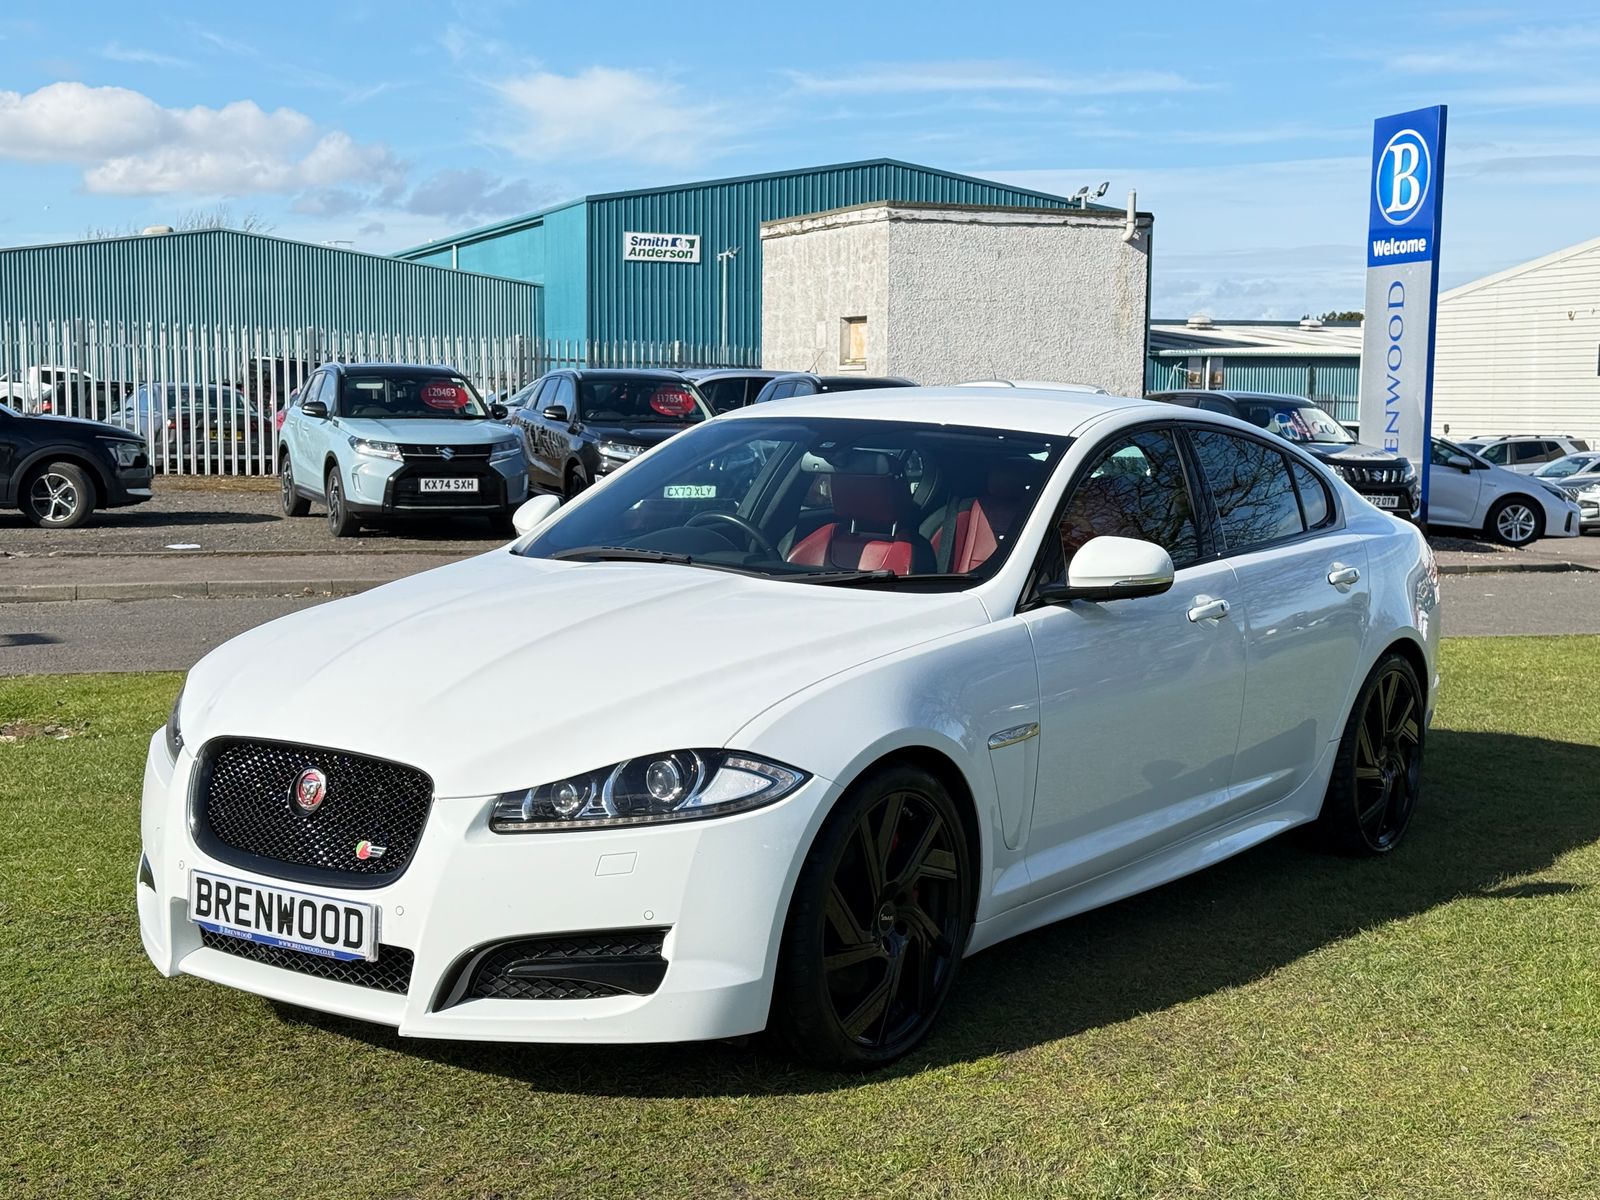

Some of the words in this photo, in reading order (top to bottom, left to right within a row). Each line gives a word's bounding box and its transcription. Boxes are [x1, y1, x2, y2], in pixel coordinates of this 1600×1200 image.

[1386, 142, 1420, 214] B
[630, 235, 669, 248] Smith
[1373, 237, 1427, 257] Welcome
[628, 247, 694, 259] Anderson
[1384, 280, 1406, 453] ENWOOD
[424, 479, 451, 490] KX74
[453, 479, 474, 490] SXH
[667, 487, 692, 497] CX73
[694, 487, 712, 497] XLY
[1381, 496, 1396, 506] OTN
[195, 876, 364, 949] BRENWOOD
